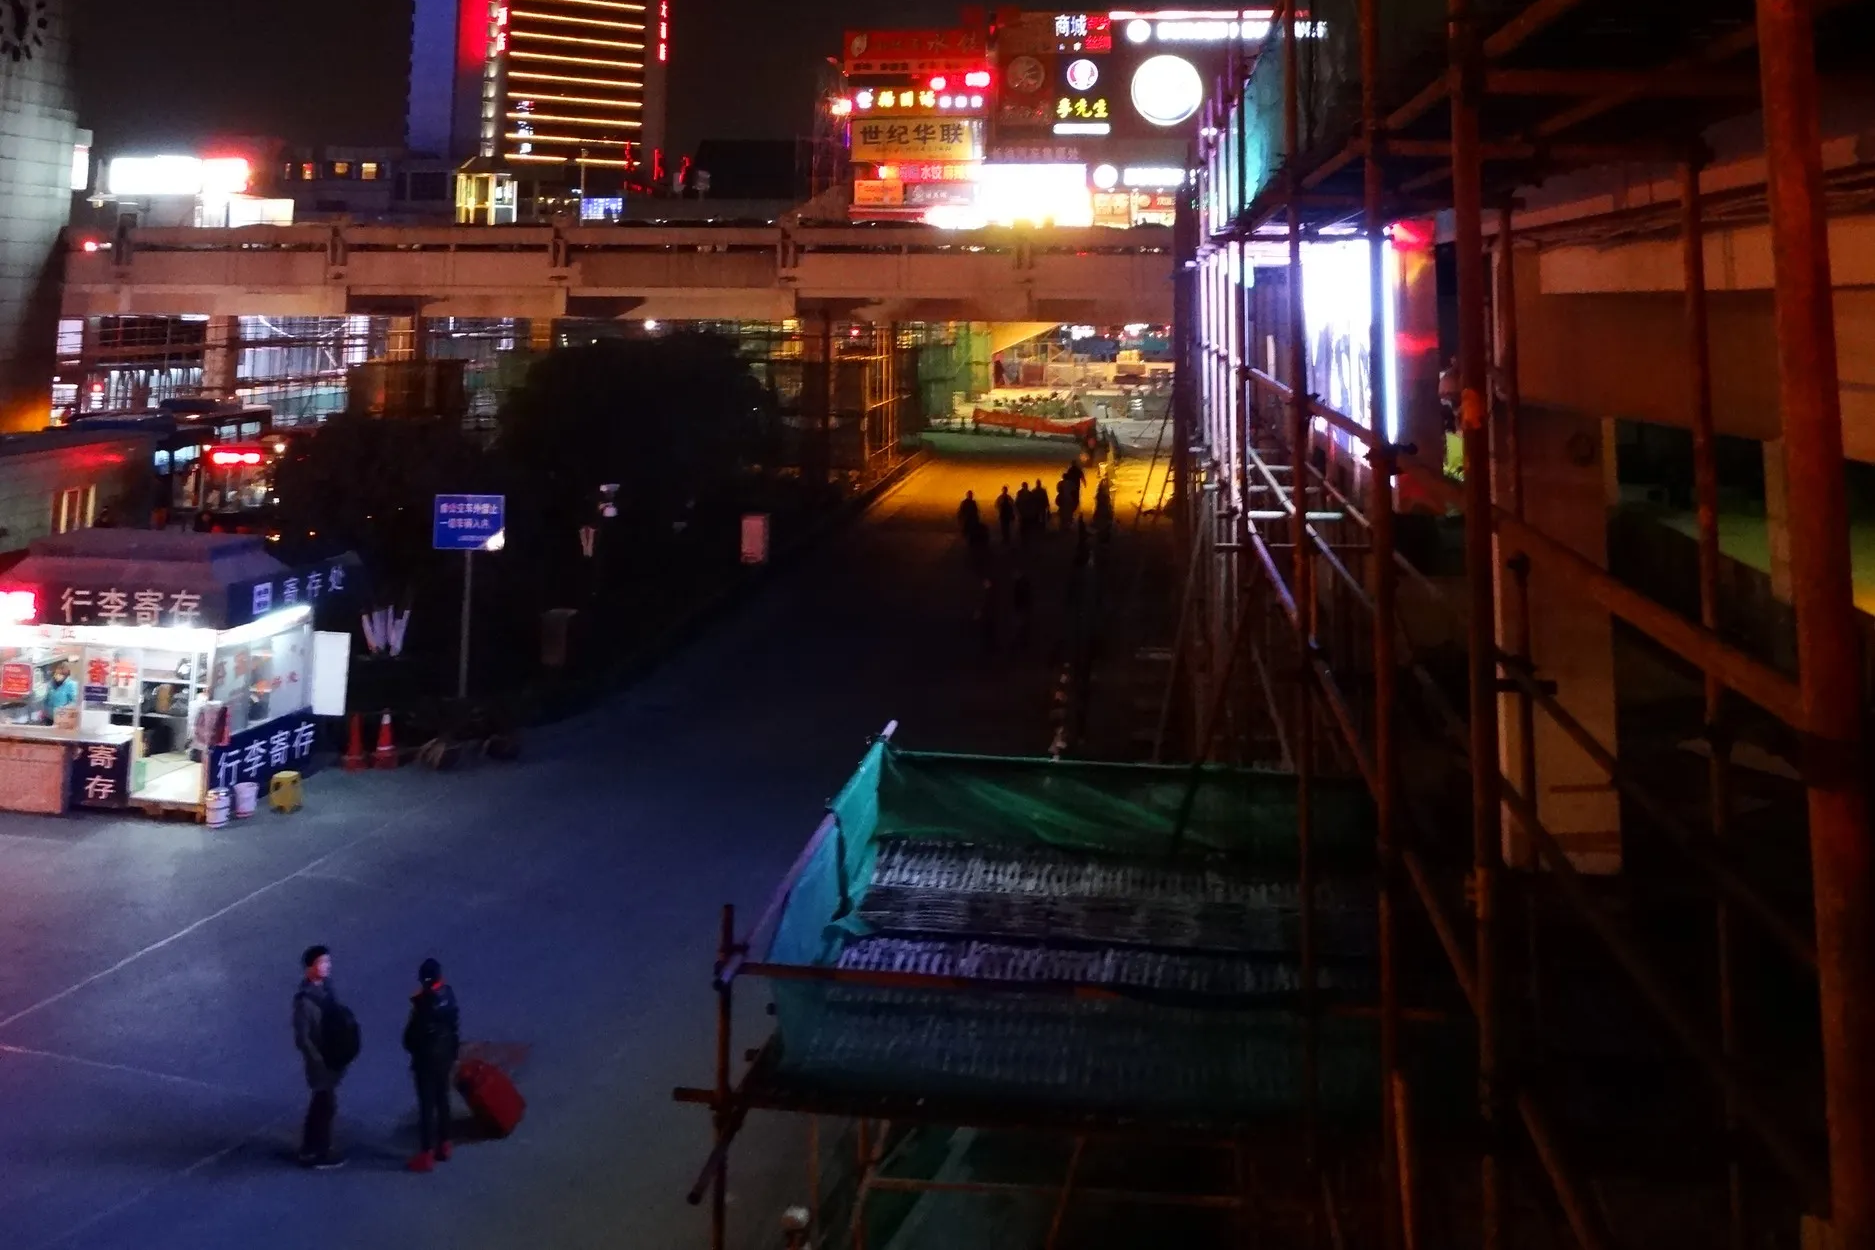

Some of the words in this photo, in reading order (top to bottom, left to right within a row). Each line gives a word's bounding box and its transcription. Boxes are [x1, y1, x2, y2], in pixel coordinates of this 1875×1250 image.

[1055, 14, 1088, 37] 商城
[860, 124, 964, 146] 世纪华联
[61, 587, 201, 626] 行李寄存
[85, 745, 118, 800] 寄存
[217, 721, 316, 787] 行李寄存
